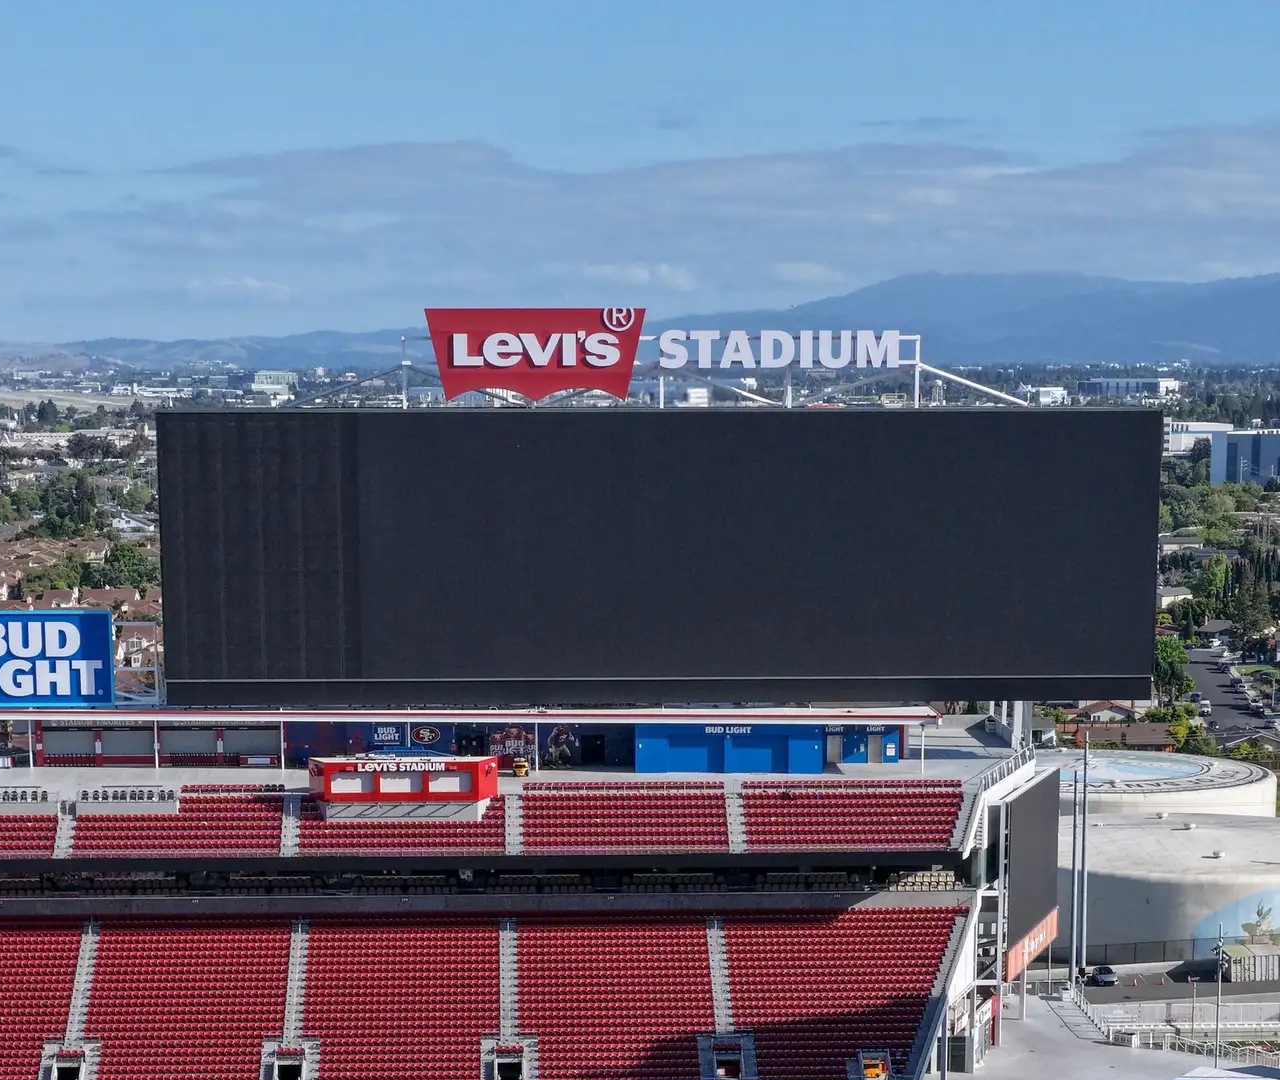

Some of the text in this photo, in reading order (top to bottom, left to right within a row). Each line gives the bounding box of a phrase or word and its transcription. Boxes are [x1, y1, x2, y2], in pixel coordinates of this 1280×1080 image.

[452, 329, 622, 367] LeVI'S
[659, 329, 900, 369] STADIUM
[399, 763, 445, 771] STADIUM
